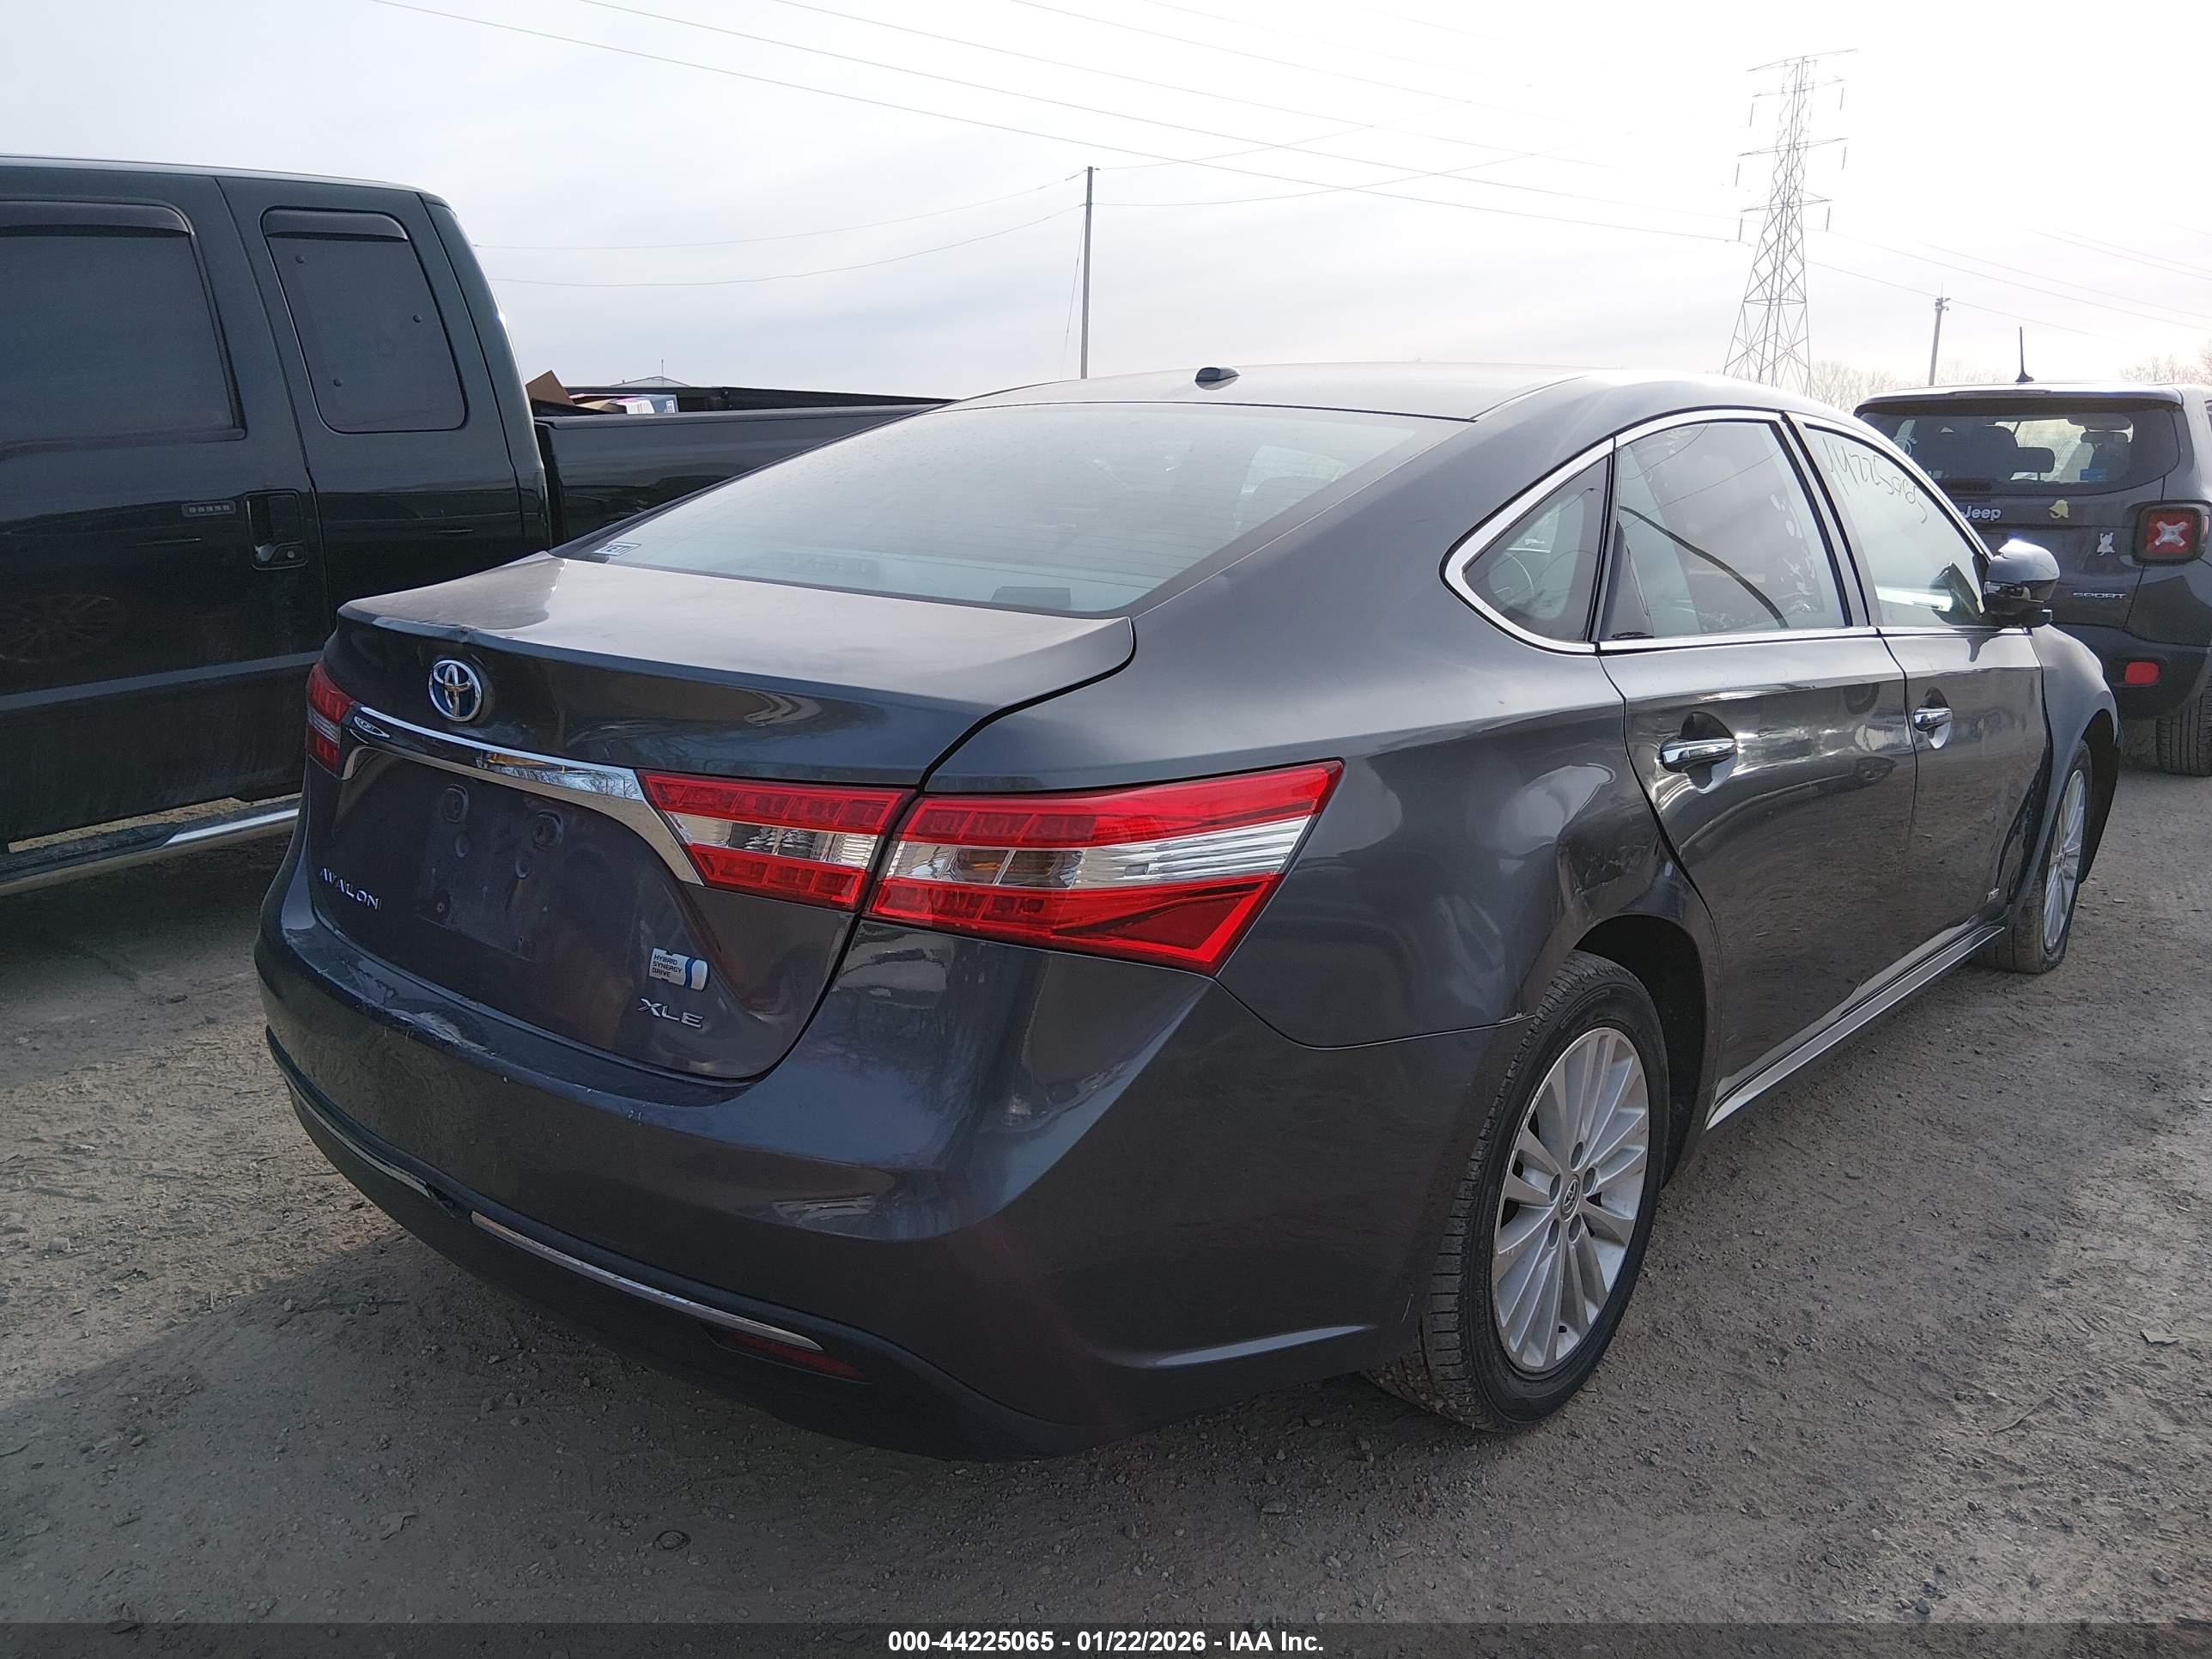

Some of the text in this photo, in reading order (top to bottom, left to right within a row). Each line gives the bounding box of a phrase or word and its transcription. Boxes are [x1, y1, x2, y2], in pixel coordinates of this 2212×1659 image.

[1960, 505, 2002, 521] Jeep
[319, 867, 382, 910] AVALON
[653, 953, 678, 966] HYBRID
[653, 960, 683, 973] SYNERGY
[652, 967, 672, 978] DRIVE
[637, 998, 704, 1029] XLE
